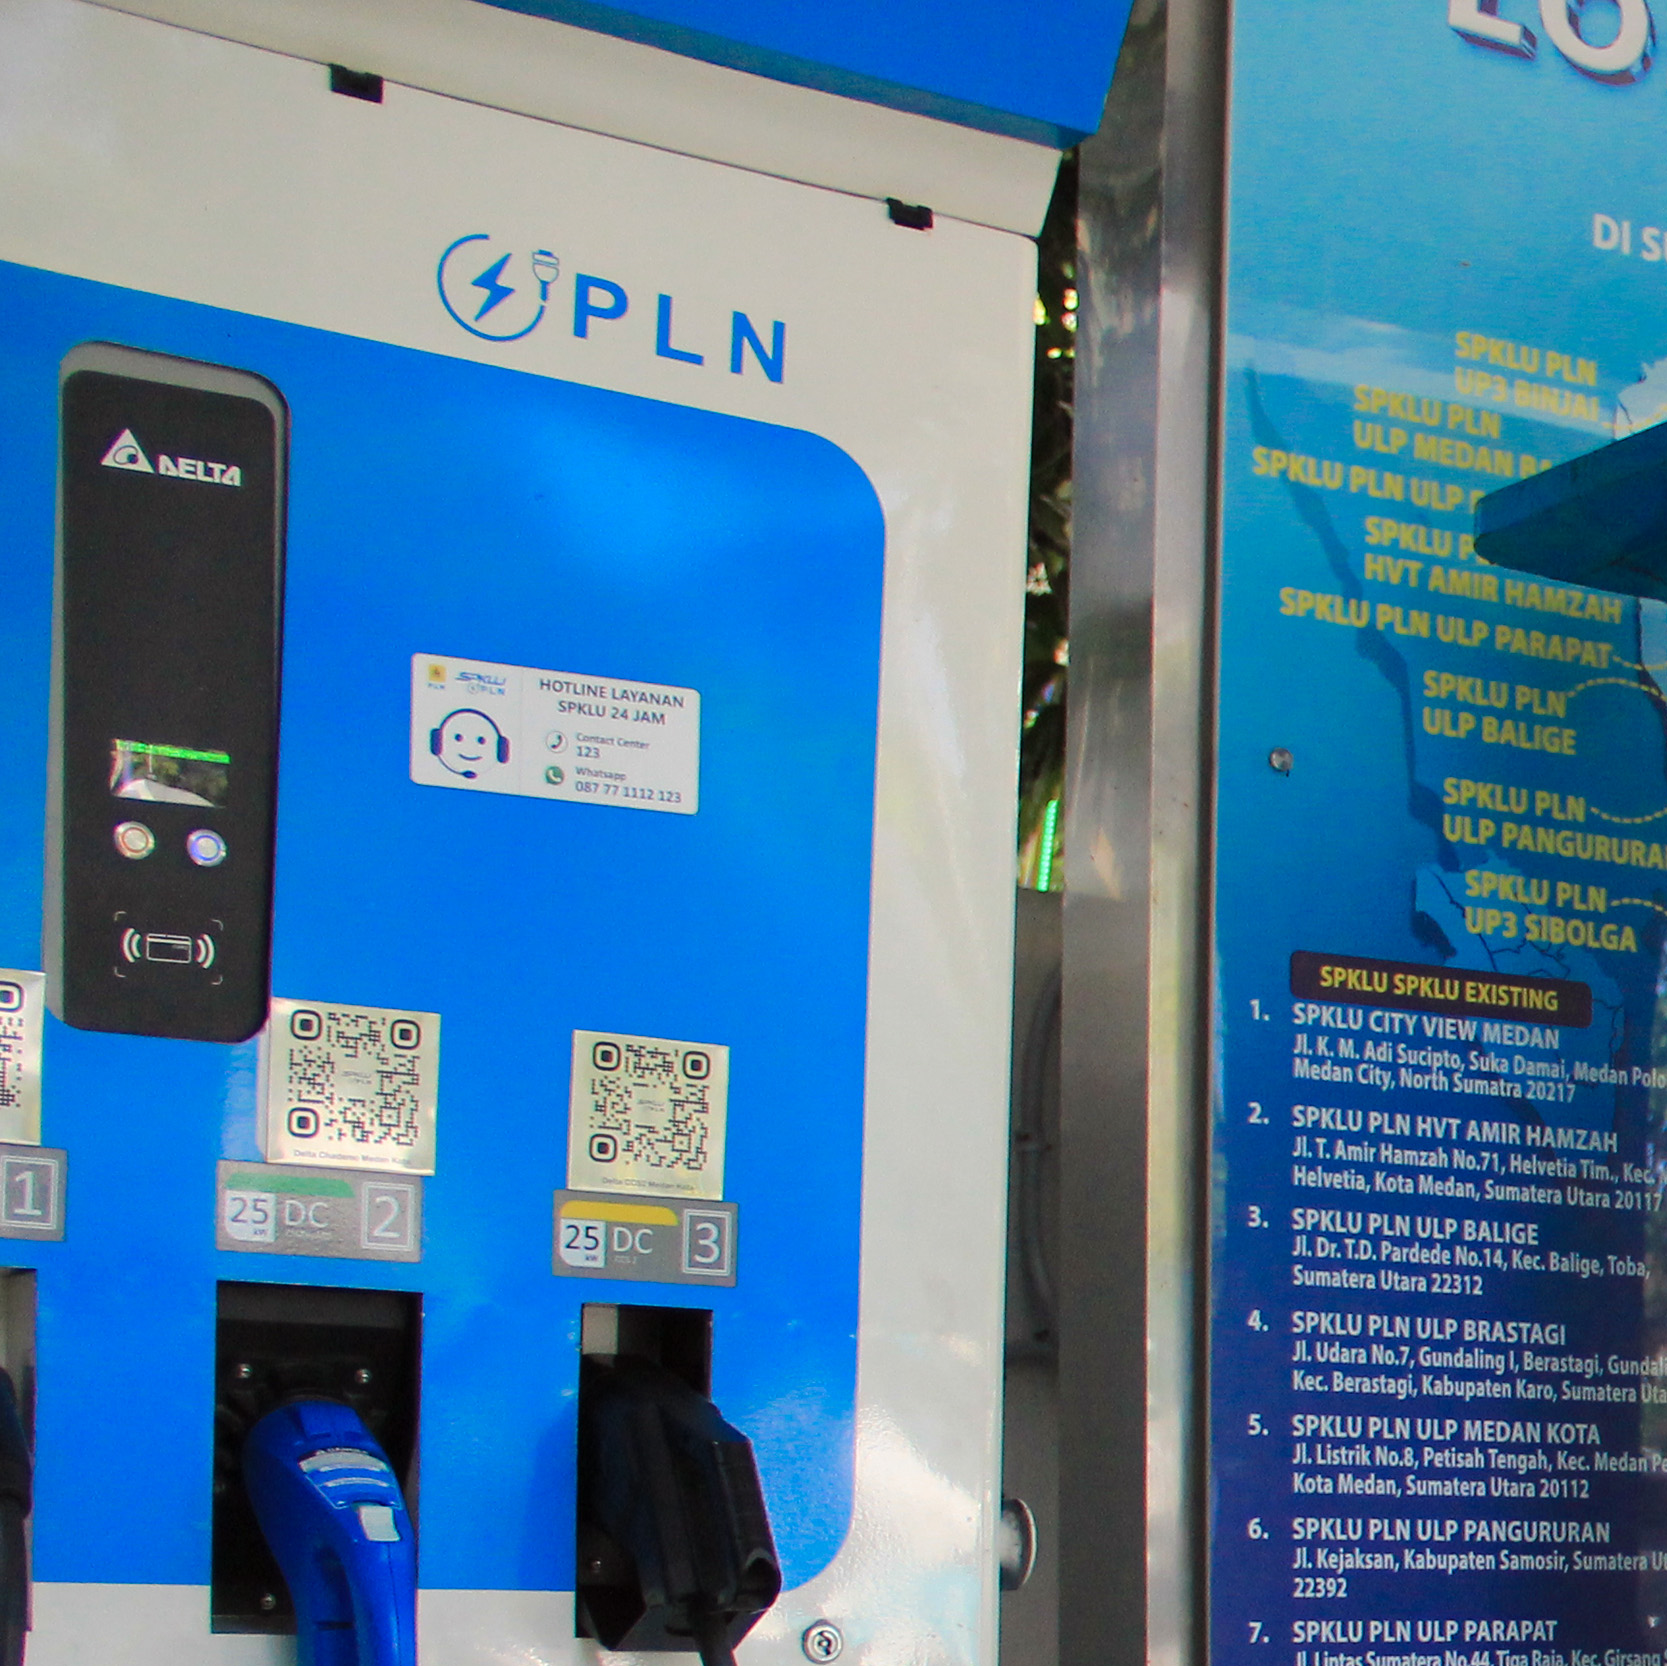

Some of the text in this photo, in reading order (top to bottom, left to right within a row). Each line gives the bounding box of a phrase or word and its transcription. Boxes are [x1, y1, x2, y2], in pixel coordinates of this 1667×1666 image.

[1592, 212, 1633, 260] DI
[573, 273, 788, 385] PLN
[158, 452, 243, 488] DELTA
[1364, 553, 1622, 624] HVT AMIR HAMZAH
[1280, 587, 1613, 669] SPKLU PLN ULP PARAPAT
[539, 677, 686, 709] HOTLINE LAYANAN
[558, 700, 667, 726] SPKLU 24 JAM
[1423, 670, 1566, 718] SPKLU PLN
[575, 732, 651, 750] Contact Center
[1422, 706, 1577, 756] ULP BALIGE
[575, 746, 600, 759] 123
[575, 766, 628, 782] Whatsapp
[575, 780, 682, 803] 087 77 1112 123
[1443, 777, 1586, 822] SPKLU PLN
[1443, 814, 1494, 845] ULP
[1465, 869, 1607, 913] SPKLU PLN
[1465, 906, 1637, 953] UP3 SIBOLGA
[1320, 964, 1558, 1011] SPKLU SPKLU EXISTING
[1250, 1000, 1560, 1050] 1. SPKLU CITY VIEW MEDAN
[1293, 1059, 1576, 1103] Medan City, North Sumatra 20217
[1247, 1102, 1618, 1154] 2. SPKLU PLN HVT AMIR HAMZAH
[14, 1170, 43, 1216] 1
[230, 1195, 399, 1238] 25 DC 2
[1247, 1206, 1538, 1246] 3. SPKLU PLN ULP BALIGE
[565, 1222, 721, 1264] 25 DC 3
[1247, 1309, 1567, 1346] 4. SPKLU PLN ULP BRASTAGI
[1247, 1413, 1600, 1446] 5. SPKLU PLN ULP MEDAN KOTA
[1248, 1518, 1611, 1544] 6. SPKLU PLN ULP PANGURURAN
[1292, 1549, 1313, 1572] Jl.
[1317, 1549, 1400, 1576] Kejaksan,
[1404, 1549, 1495, 1576] Kabupaten
[1500, 1550, 1569, 1574] Samosir,
[1573, 1551, 1648, 1573] Sumatera
[1293, 1577, 1348, 1599] 22392
[1248, 1620, 1558, 1645] 7. SPKLU PLN ULP PARAPAT
